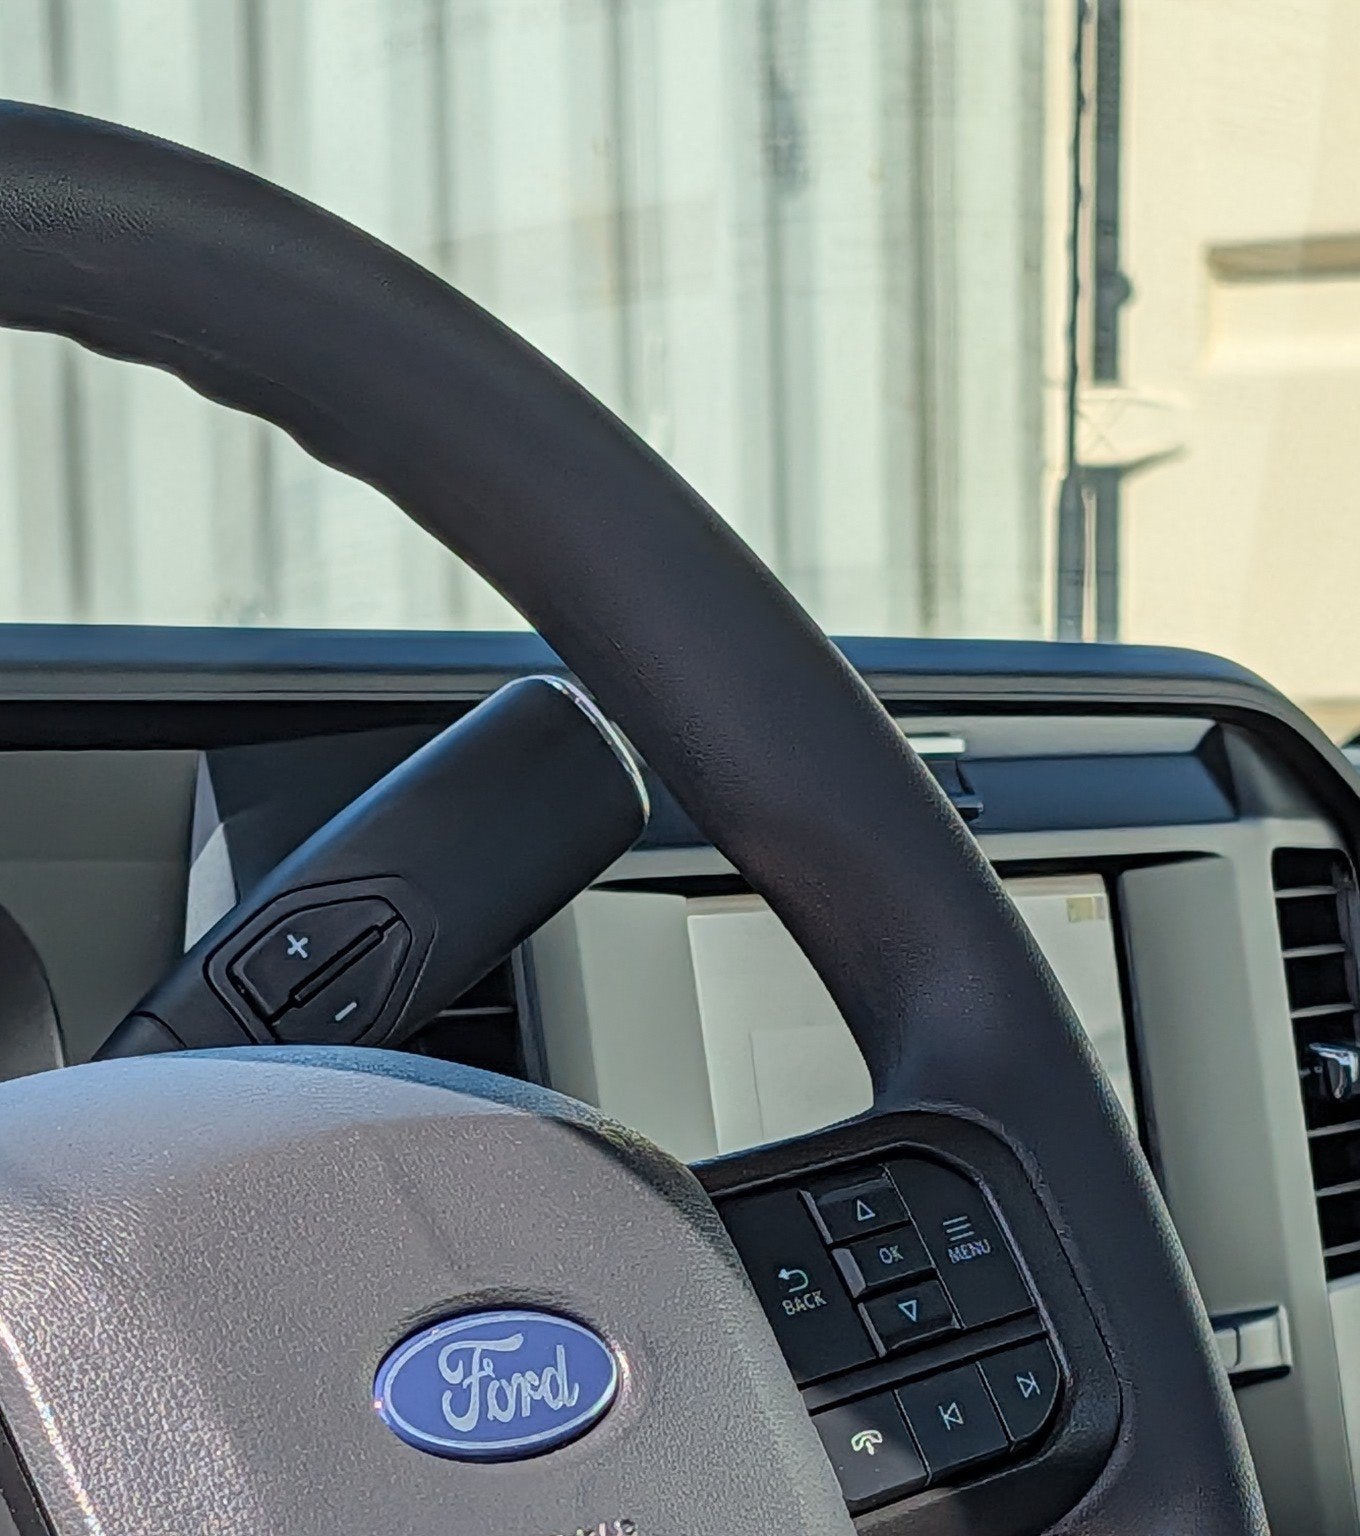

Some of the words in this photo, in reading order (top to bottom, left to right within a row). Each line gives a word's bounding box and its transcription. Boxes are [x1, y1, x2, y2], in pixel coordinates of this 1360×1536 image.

[879, 1243, 904, 1265] OK
[947, 1237, 992, 1265] MENU
[781, 1289, 828, 1316] BACK
[437, 1331, 581, 1433] Ford
